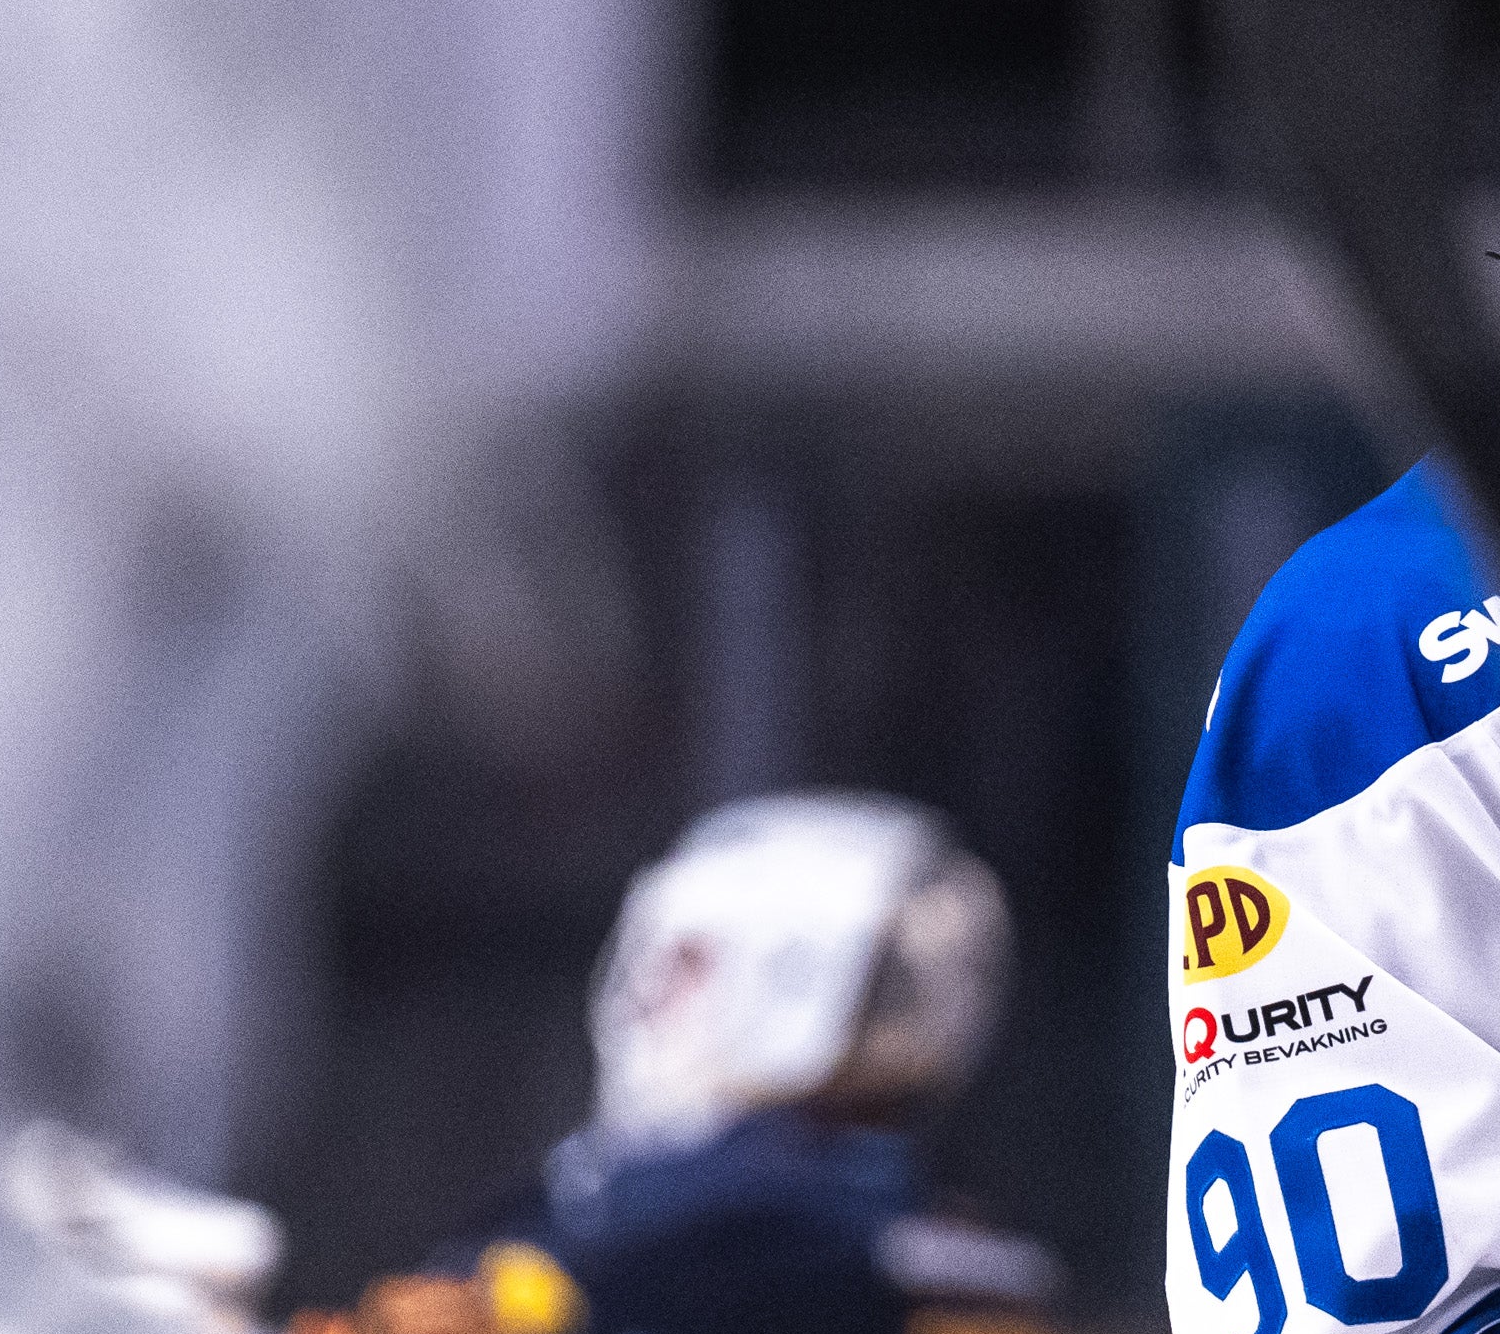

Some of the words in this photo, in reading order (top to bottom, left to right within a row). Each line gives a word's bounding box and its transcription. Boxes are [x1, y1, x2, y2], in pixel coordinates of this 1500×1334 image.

[1183, 877, 1271, 971] PD
[1183, 1053, 1237, 1108] CURITY
[1243, 1017, 1389, 1067] BEVAKNING
